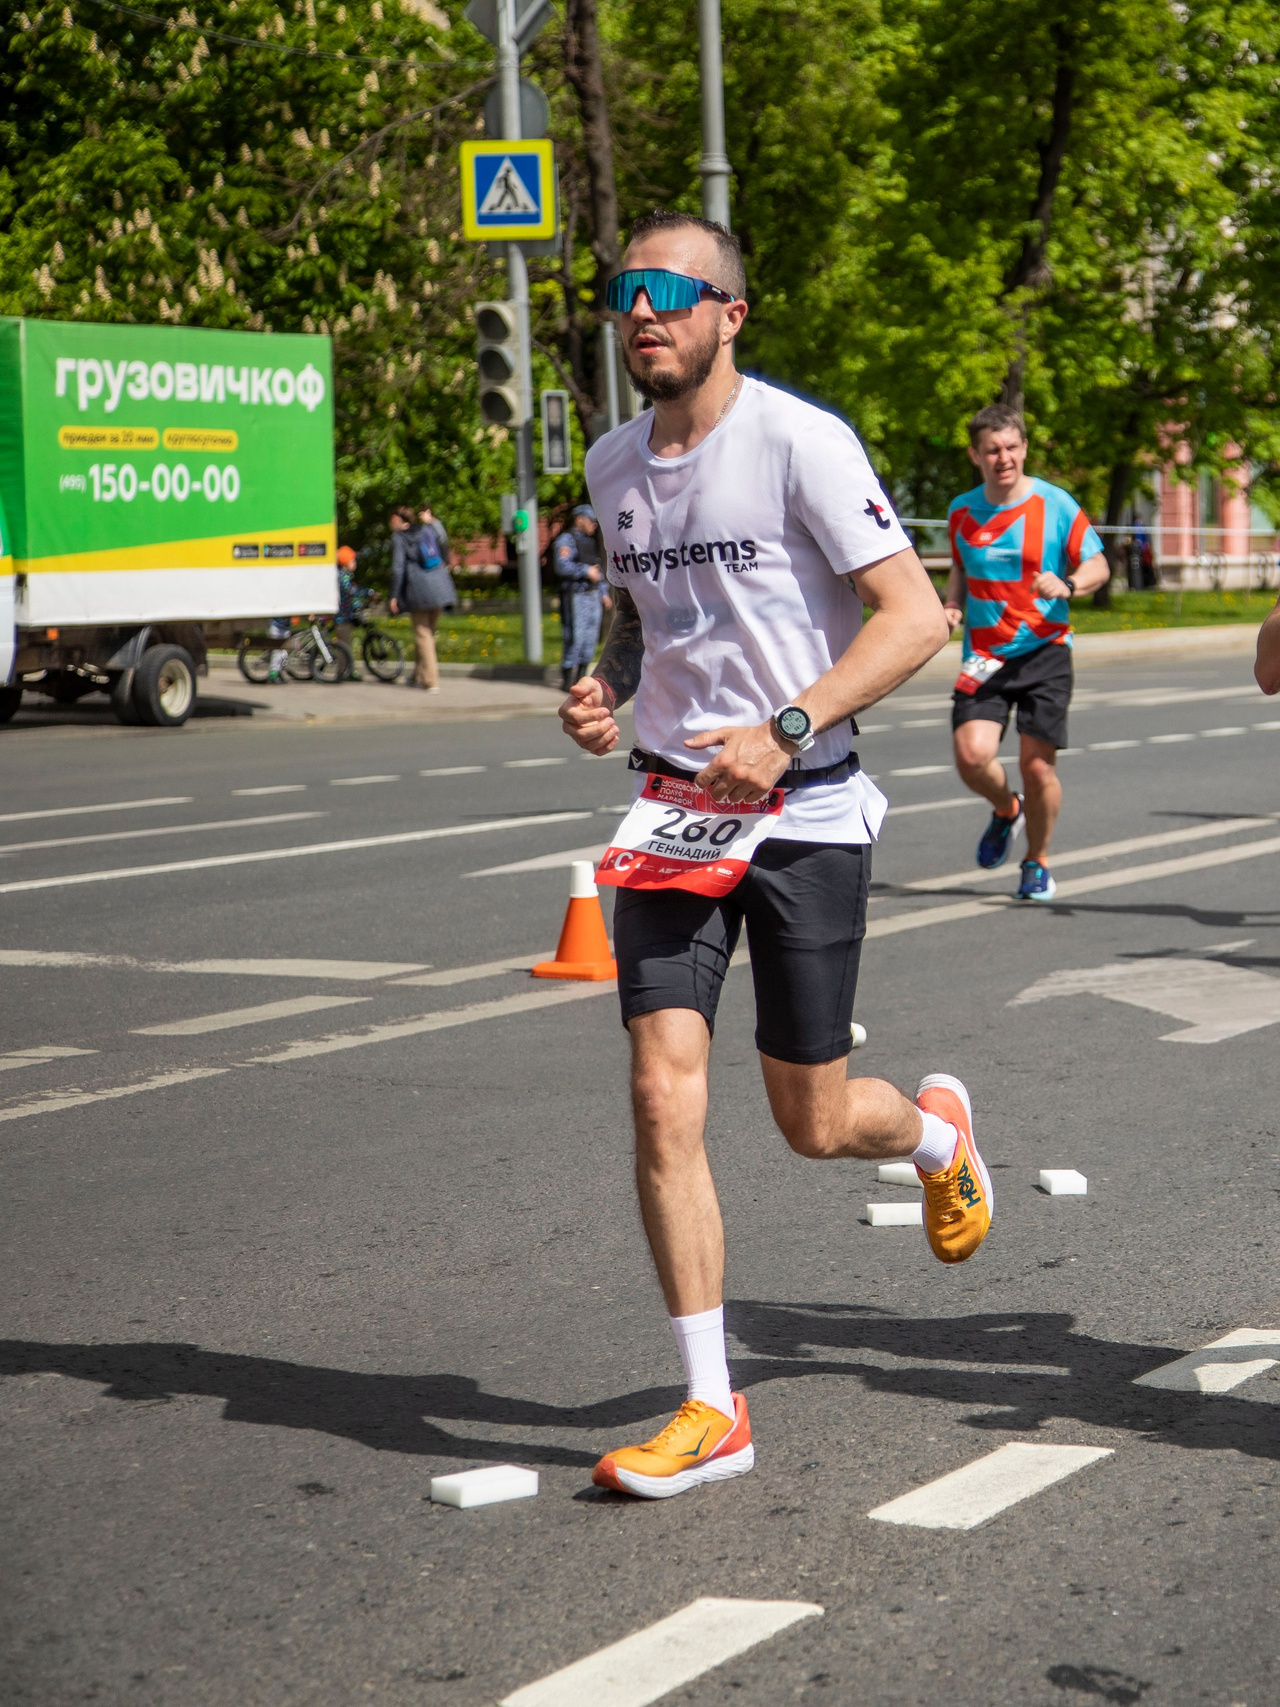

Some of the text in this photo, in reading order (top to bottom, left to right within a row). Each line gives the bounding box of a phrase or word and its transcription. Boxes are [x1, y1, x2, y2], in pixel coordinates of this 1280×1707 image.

[55, 357, 326, 413] грузовичкоф
[88, 462, 241, 502] 150-00-00
[612, 538, 758, 581] trisystems
[724, 561, 759, 574] TEAM
[651, 808, 743, 846] 260
[648, 840, 722, 860] ГЕННАДИЙ
